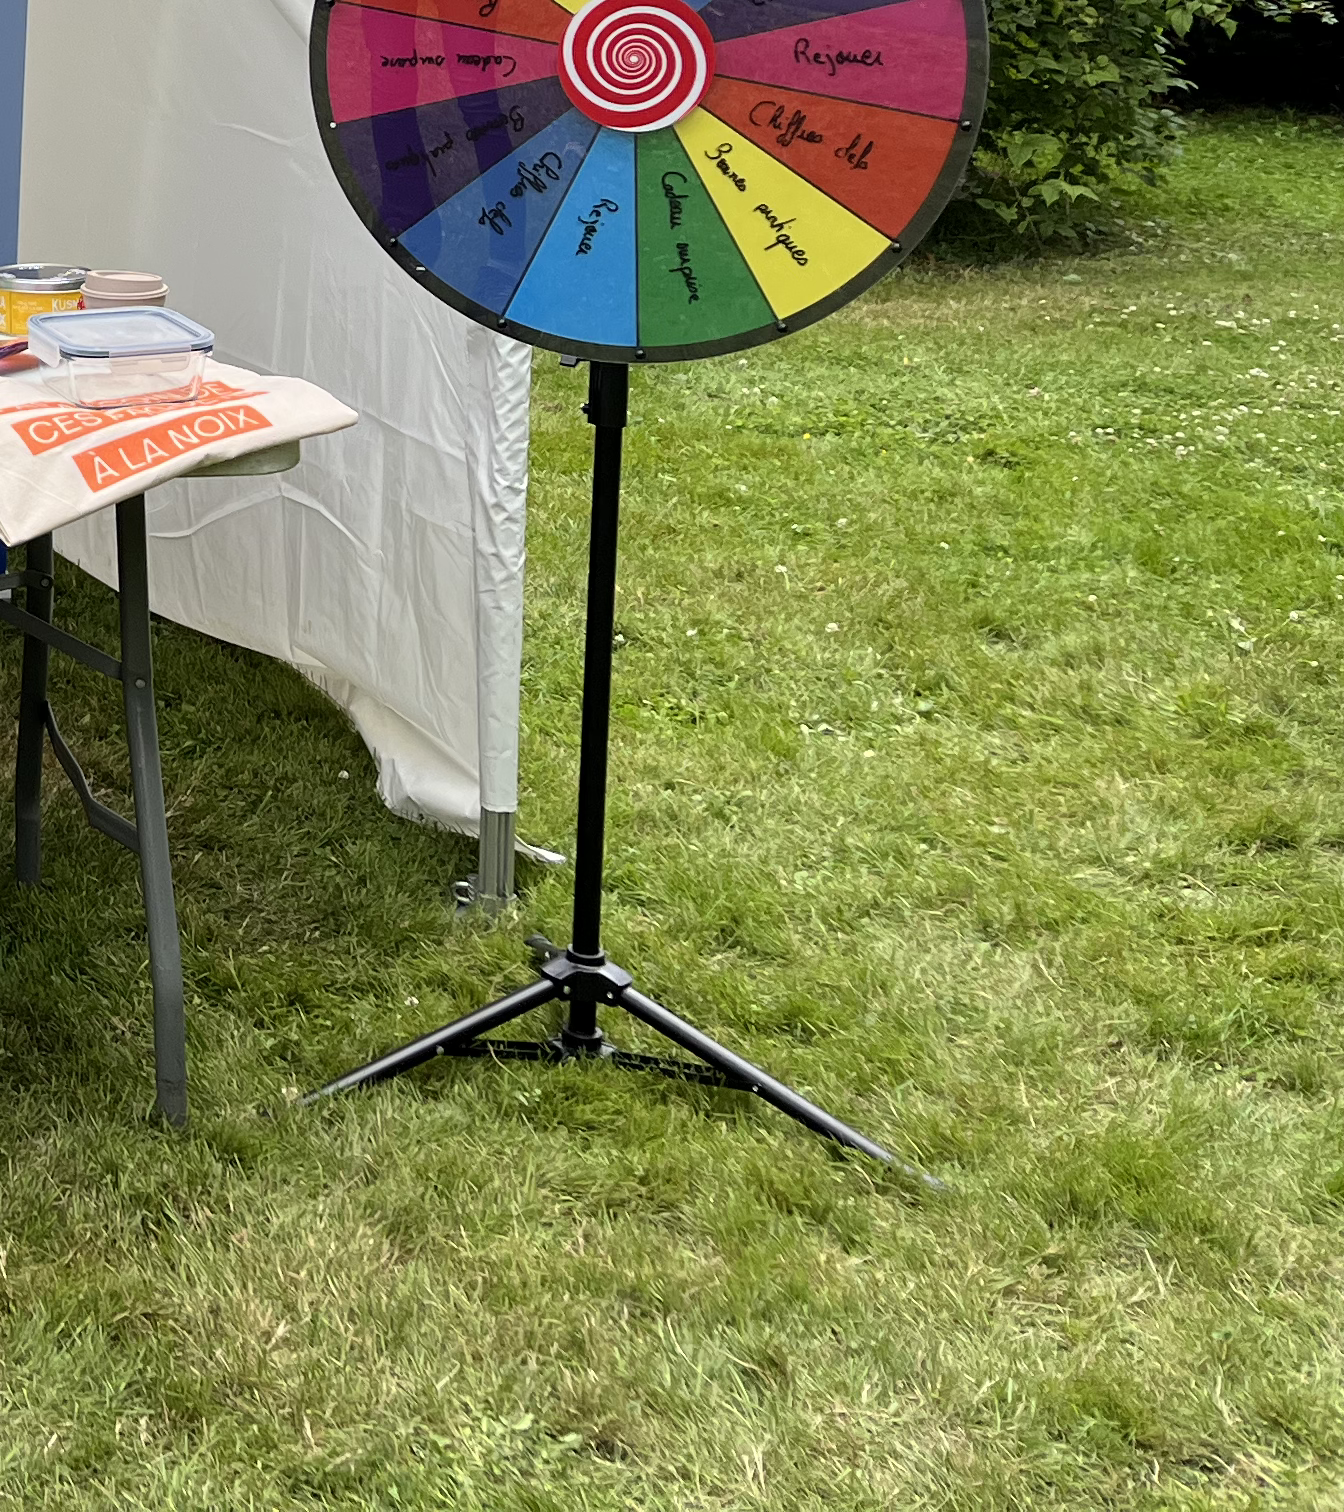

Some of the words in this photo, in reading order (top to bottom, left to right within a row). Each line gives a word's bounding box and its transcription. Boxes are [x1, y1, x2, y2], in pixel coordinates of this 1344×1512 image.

[793, 37, 884, 76] Rejouer
[28, 410, 104, 445] CES
[92, 450, 120, 486] À
[123, 437, 170, 470] LA
[167, 404, 262, 447] NOIX
